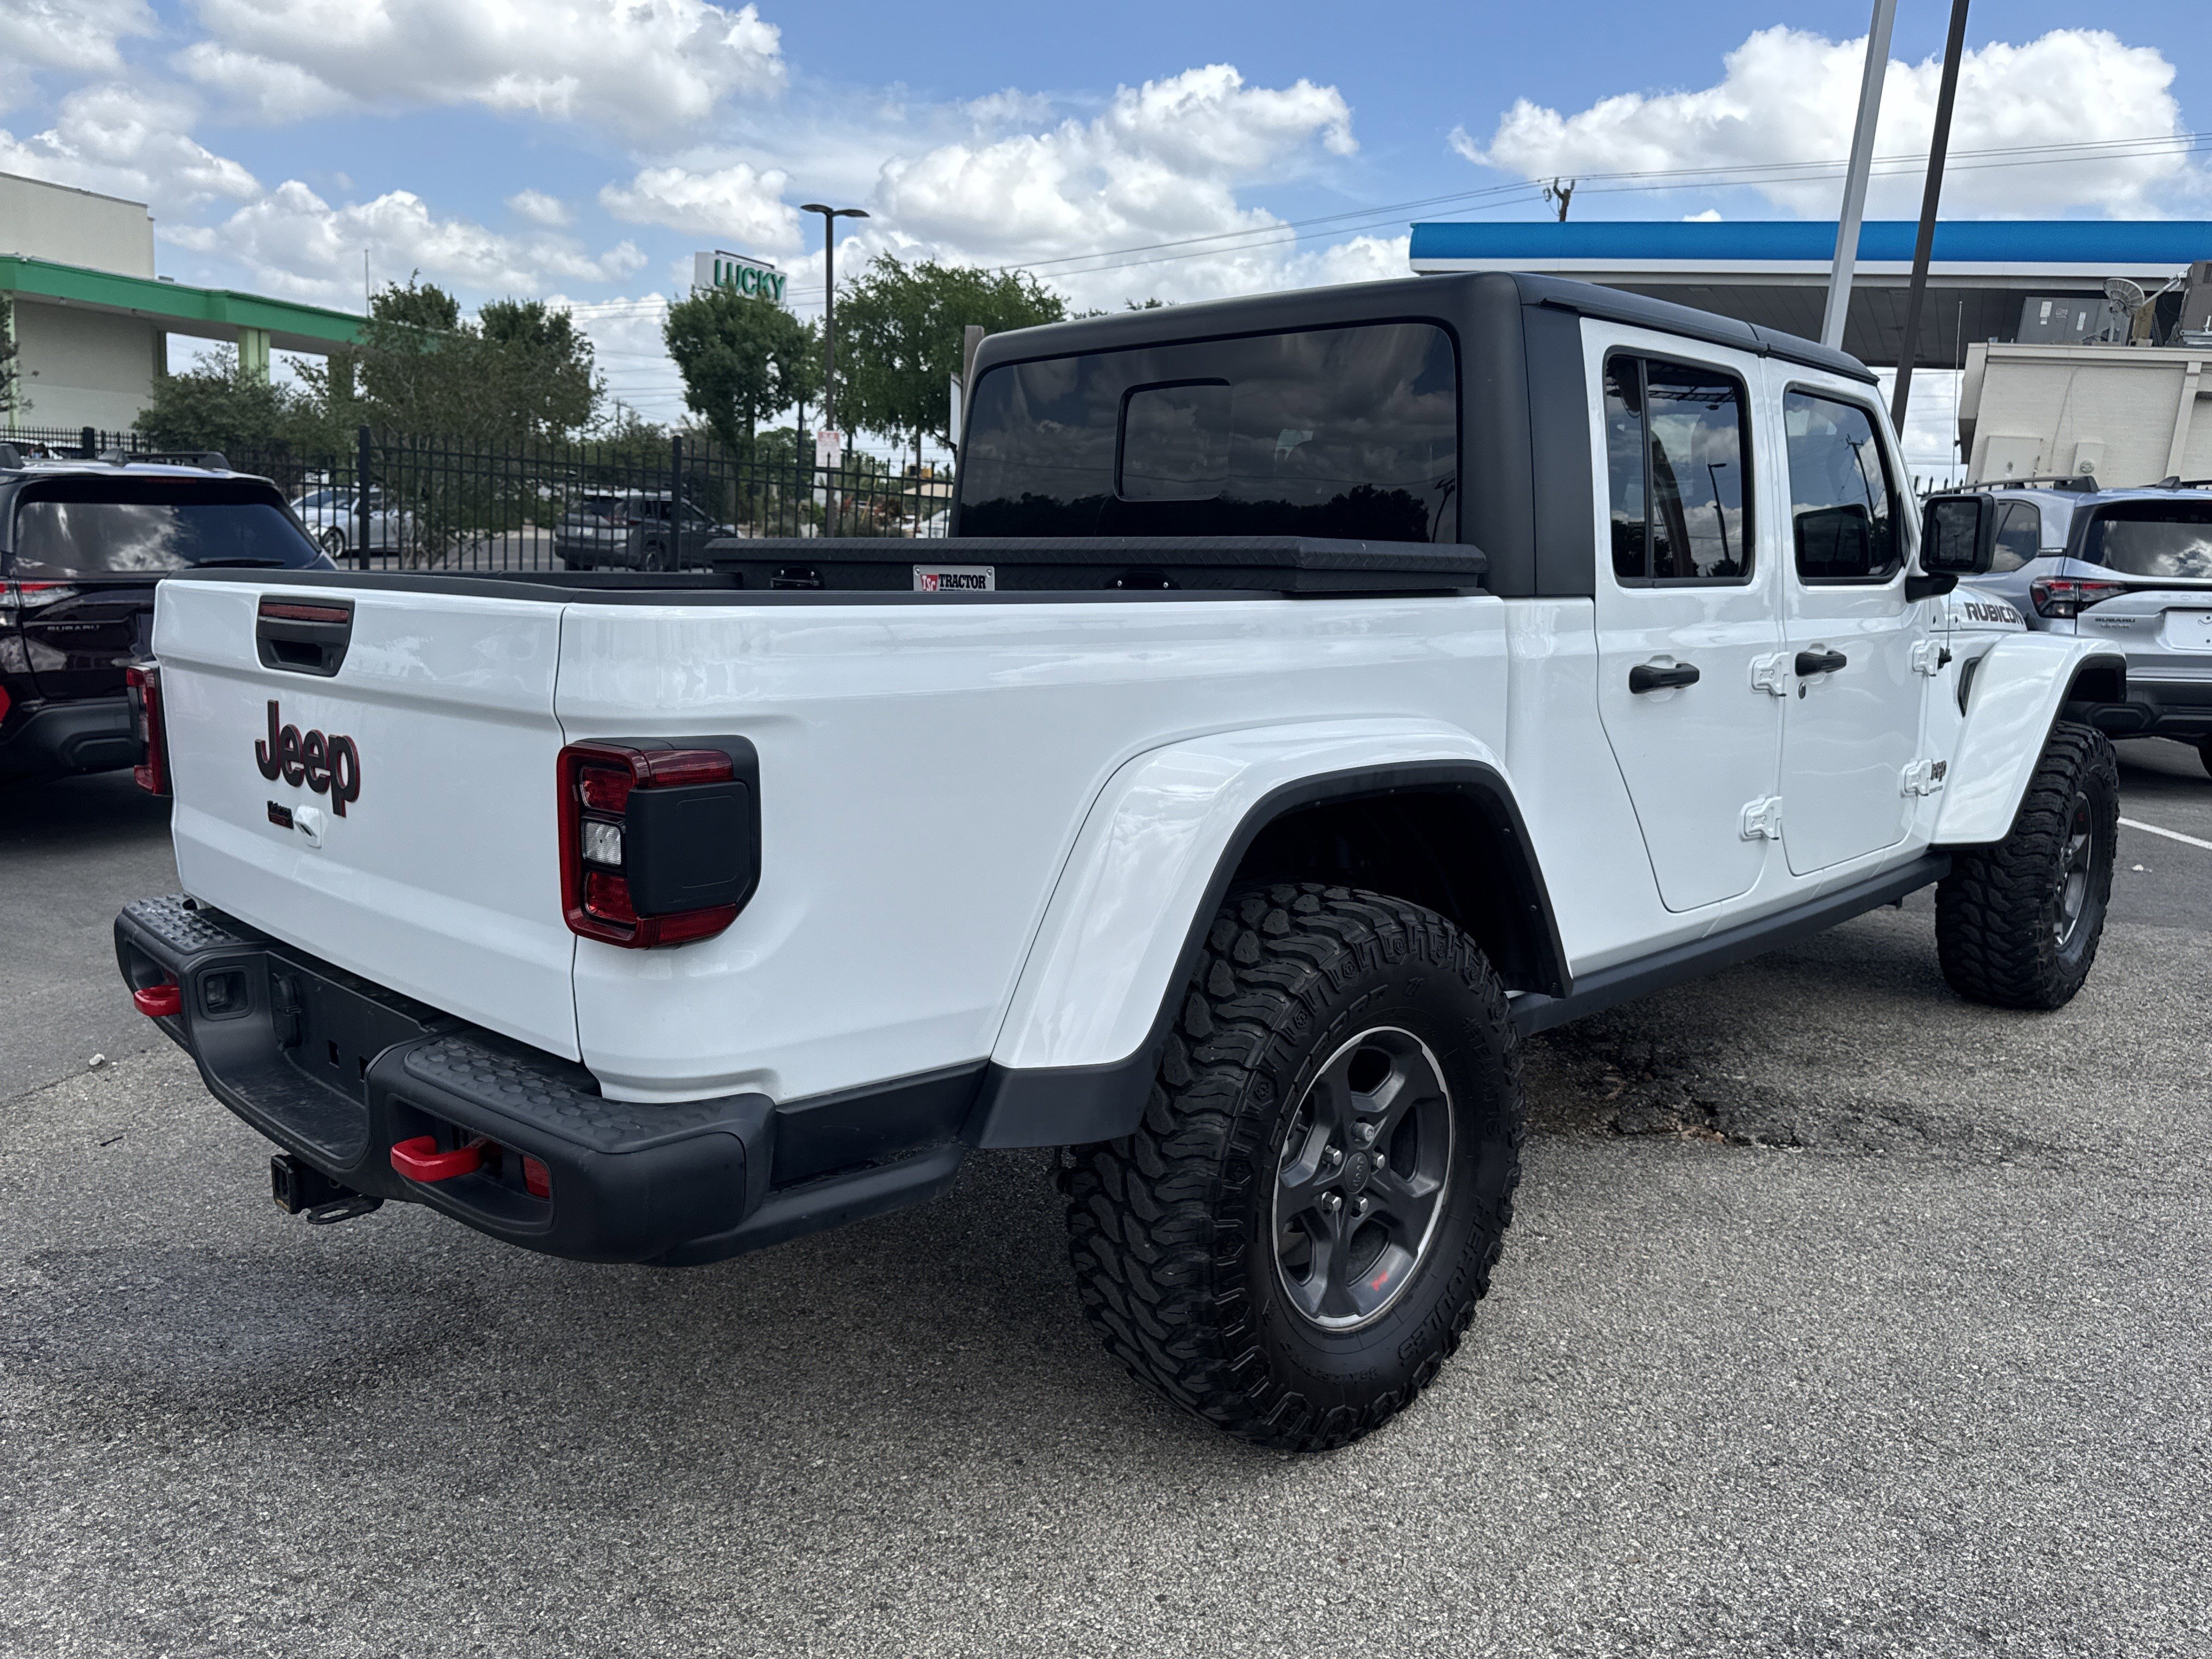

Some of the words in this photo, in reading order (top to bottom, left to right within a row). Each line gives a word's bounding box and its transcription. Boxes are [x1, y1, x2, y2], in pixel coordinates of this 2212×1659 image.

[715, 259, 785, 301] LUCKY
[938, 574, 986, 589] TRACTOR
[1963, 602, 2024, 625] RUBICON
[255, 699, 360, 818] Jeep
[1930, 760, 1947, 782] eep
